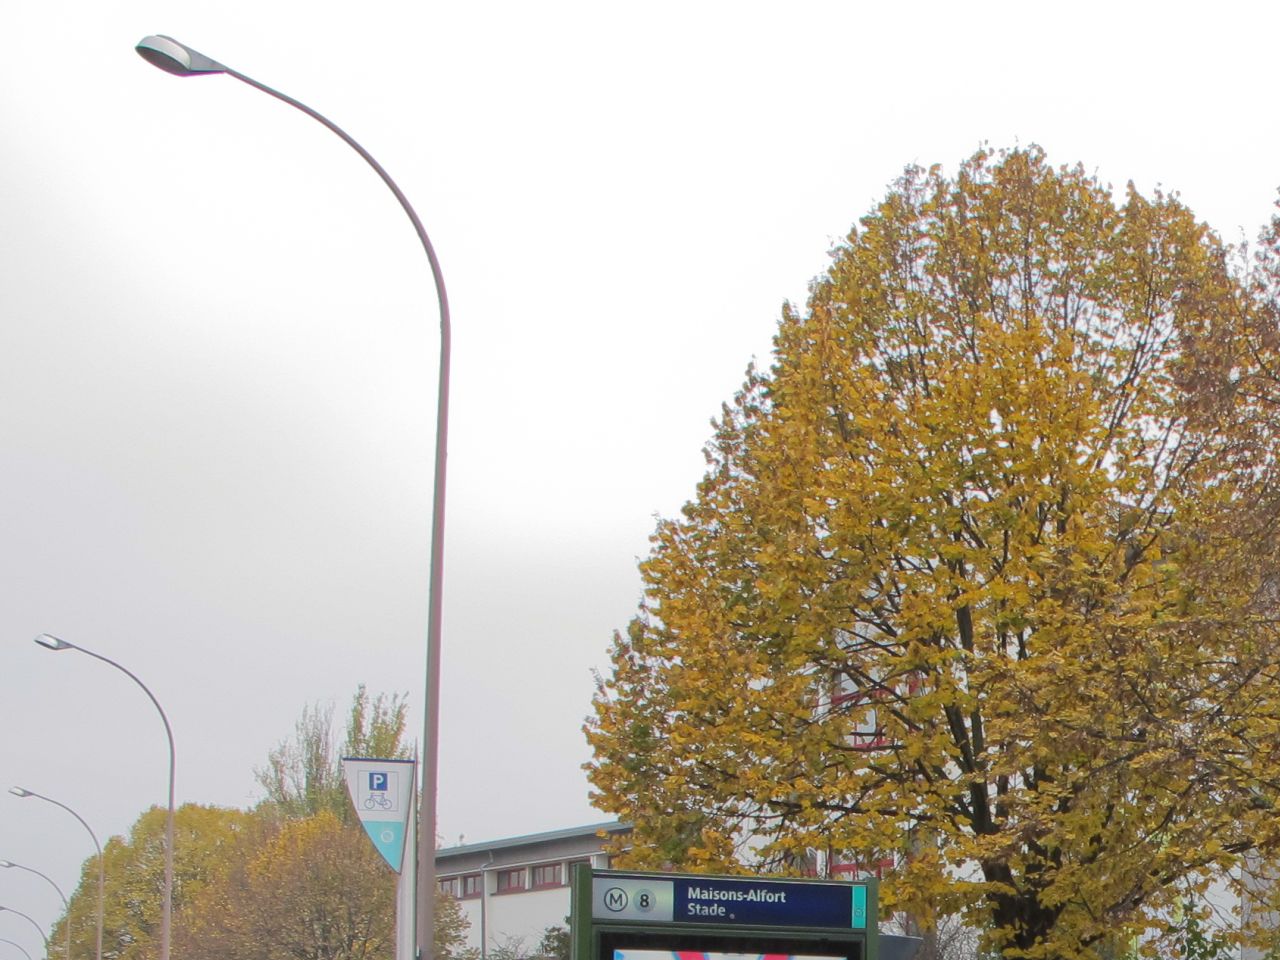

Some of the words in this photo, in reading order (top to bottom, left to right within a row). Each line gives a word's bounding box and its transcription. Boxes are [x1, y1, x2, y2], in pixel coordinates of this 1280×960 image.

[373, 774, 384, 789] P
[609, 893, 623, 907] M
[639, 893, 650, 908] 8
[687, 886, 787, 903] Maisons-Alfort
[687, 902, 726, 916] Stade
